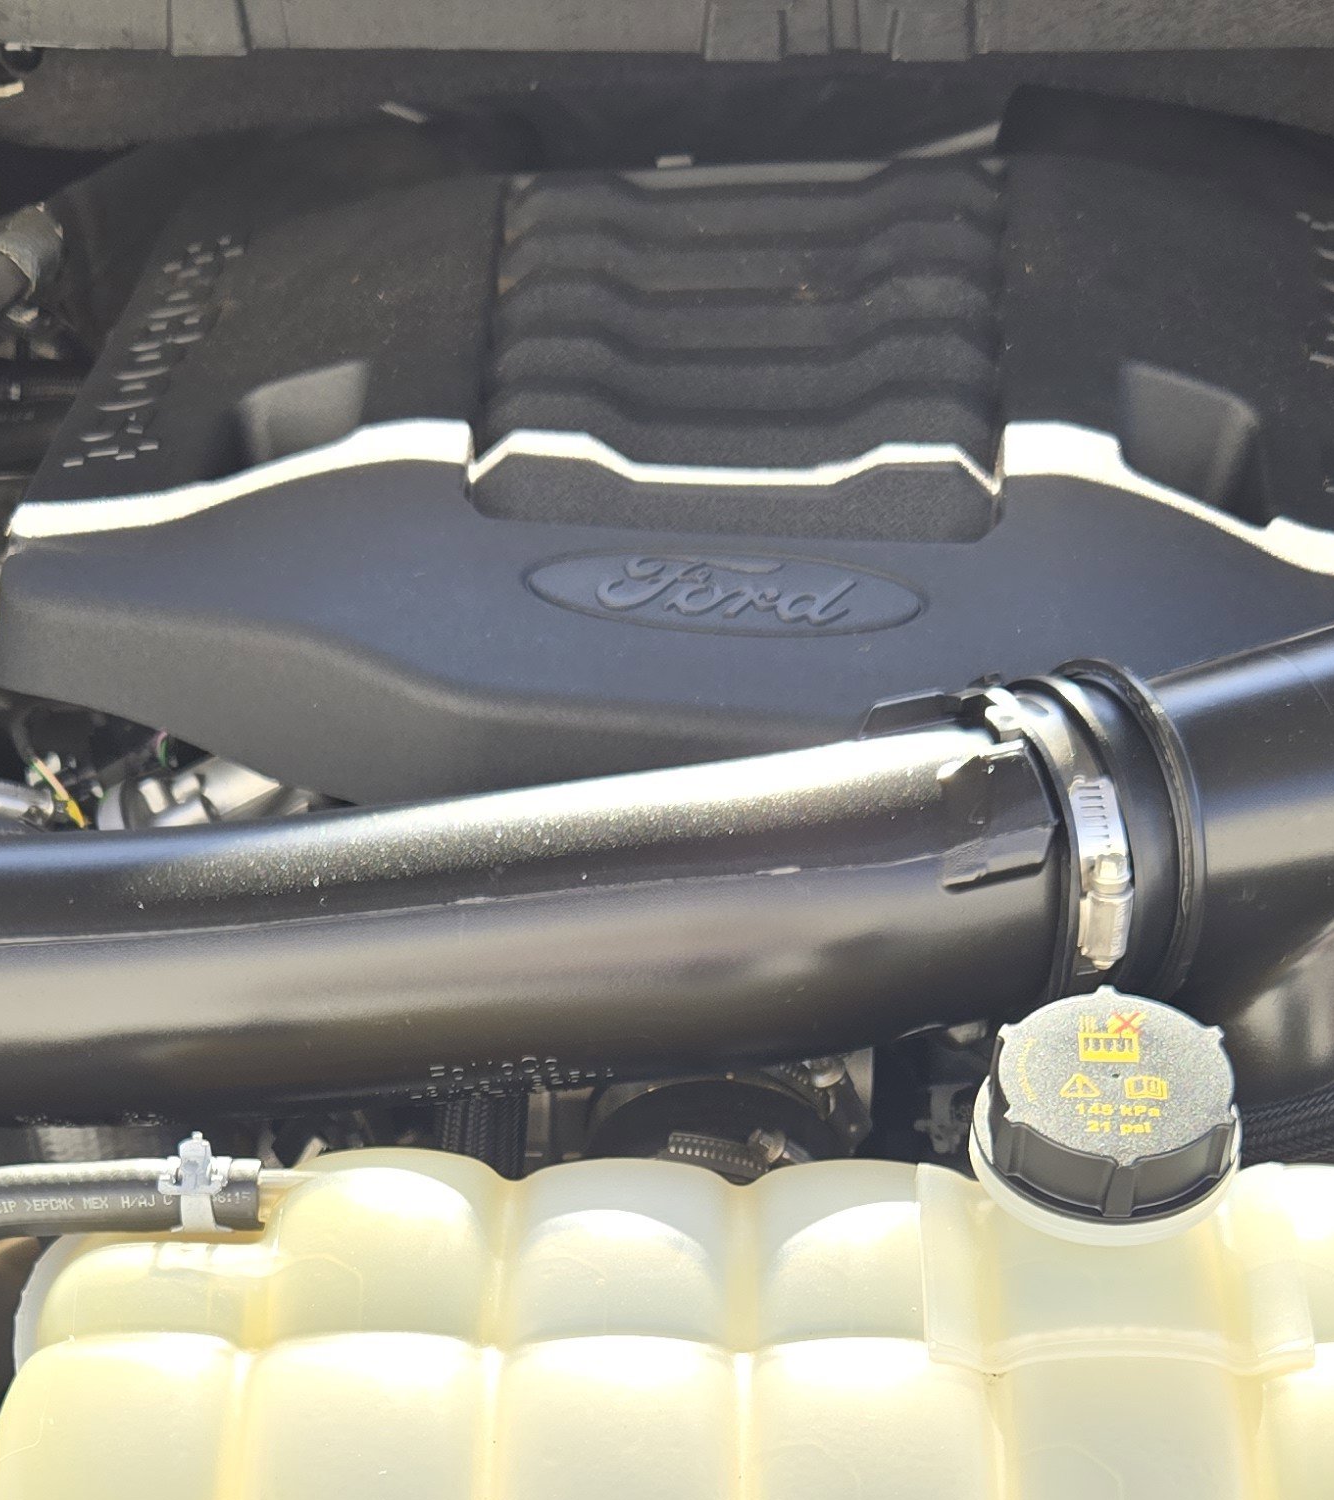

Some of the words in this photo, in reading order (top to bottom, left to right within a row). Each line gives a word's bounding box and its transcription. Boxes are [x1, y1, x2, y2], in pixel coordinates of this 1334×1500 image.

[1075, 1103, 1114, 1116] 145
[1120, 1103, 1161, 1118] kPa
[1085, 1121, 1111, 1133] 21
[1120, 1122, 1152, 1136] psi
[82, 1196, 109, 1210] MEX
